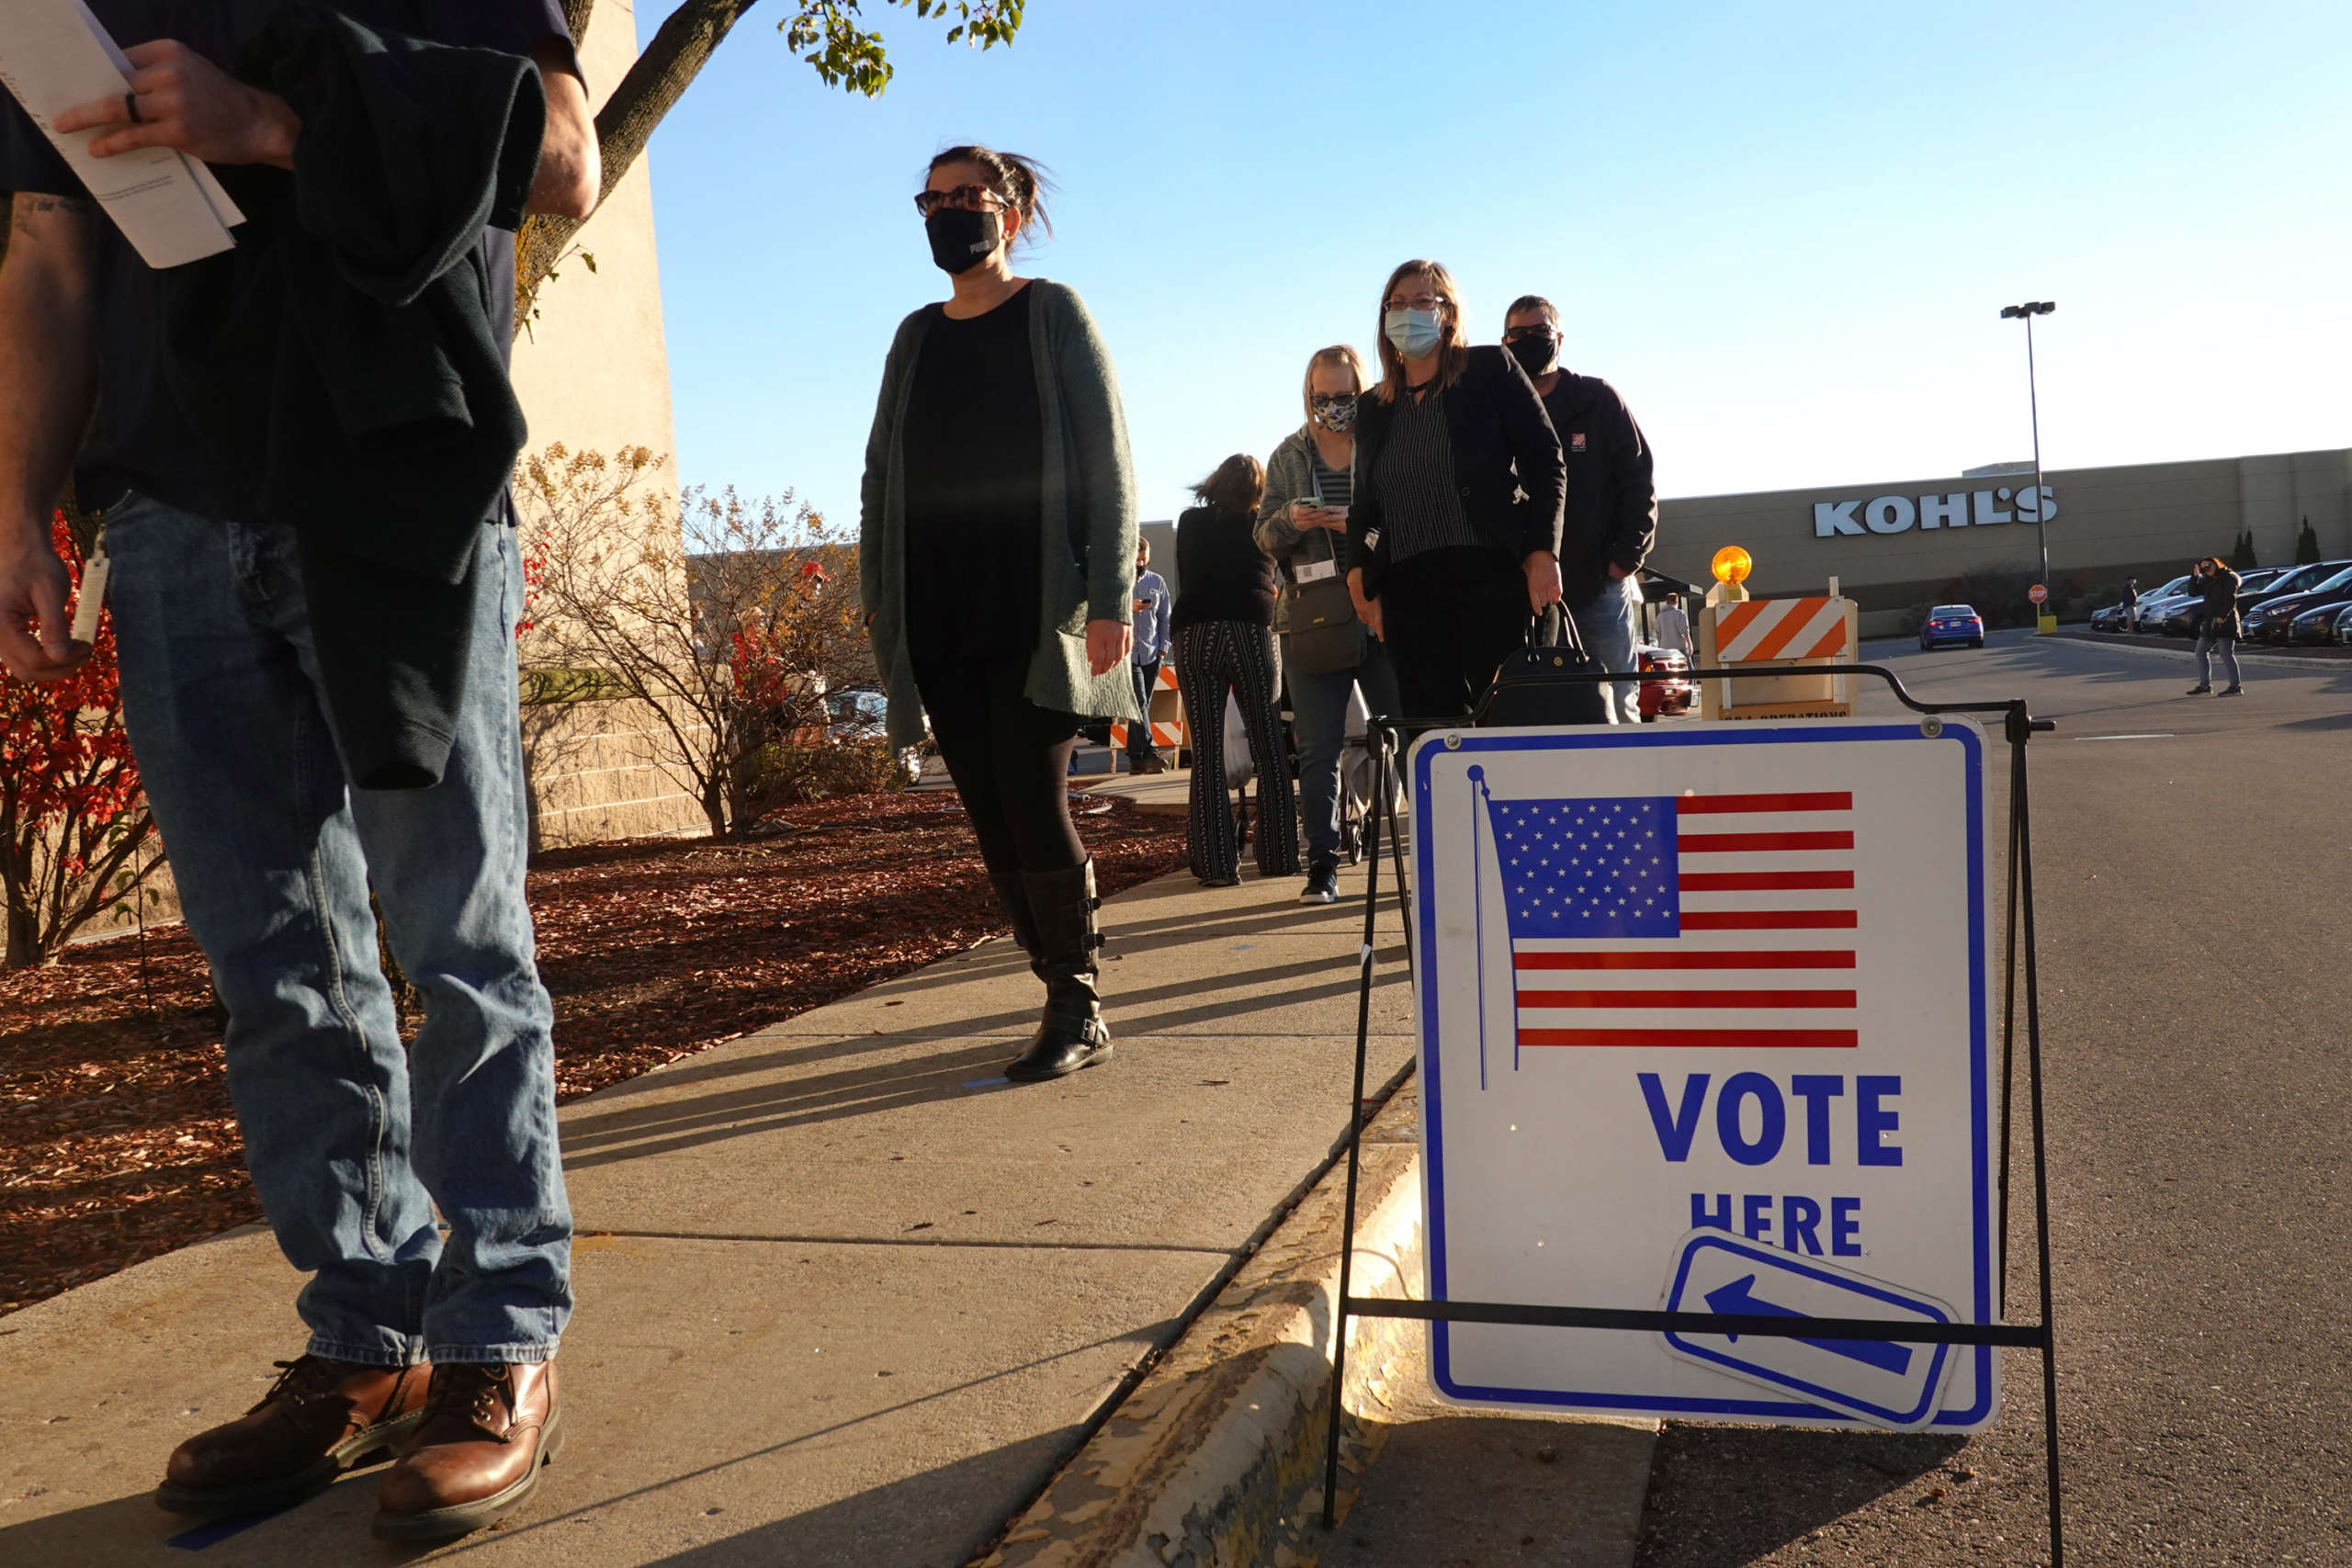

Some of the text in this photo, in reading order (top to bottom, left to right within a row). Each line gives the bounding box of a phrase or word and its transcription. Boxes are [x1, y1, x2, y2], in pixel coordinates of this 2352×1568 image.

[1813, 485, 2058, 537] KOHL'S
[1636, 1072, 1903, 1167] VOTE
[1690, 1193, 1861, 1257] HERE
